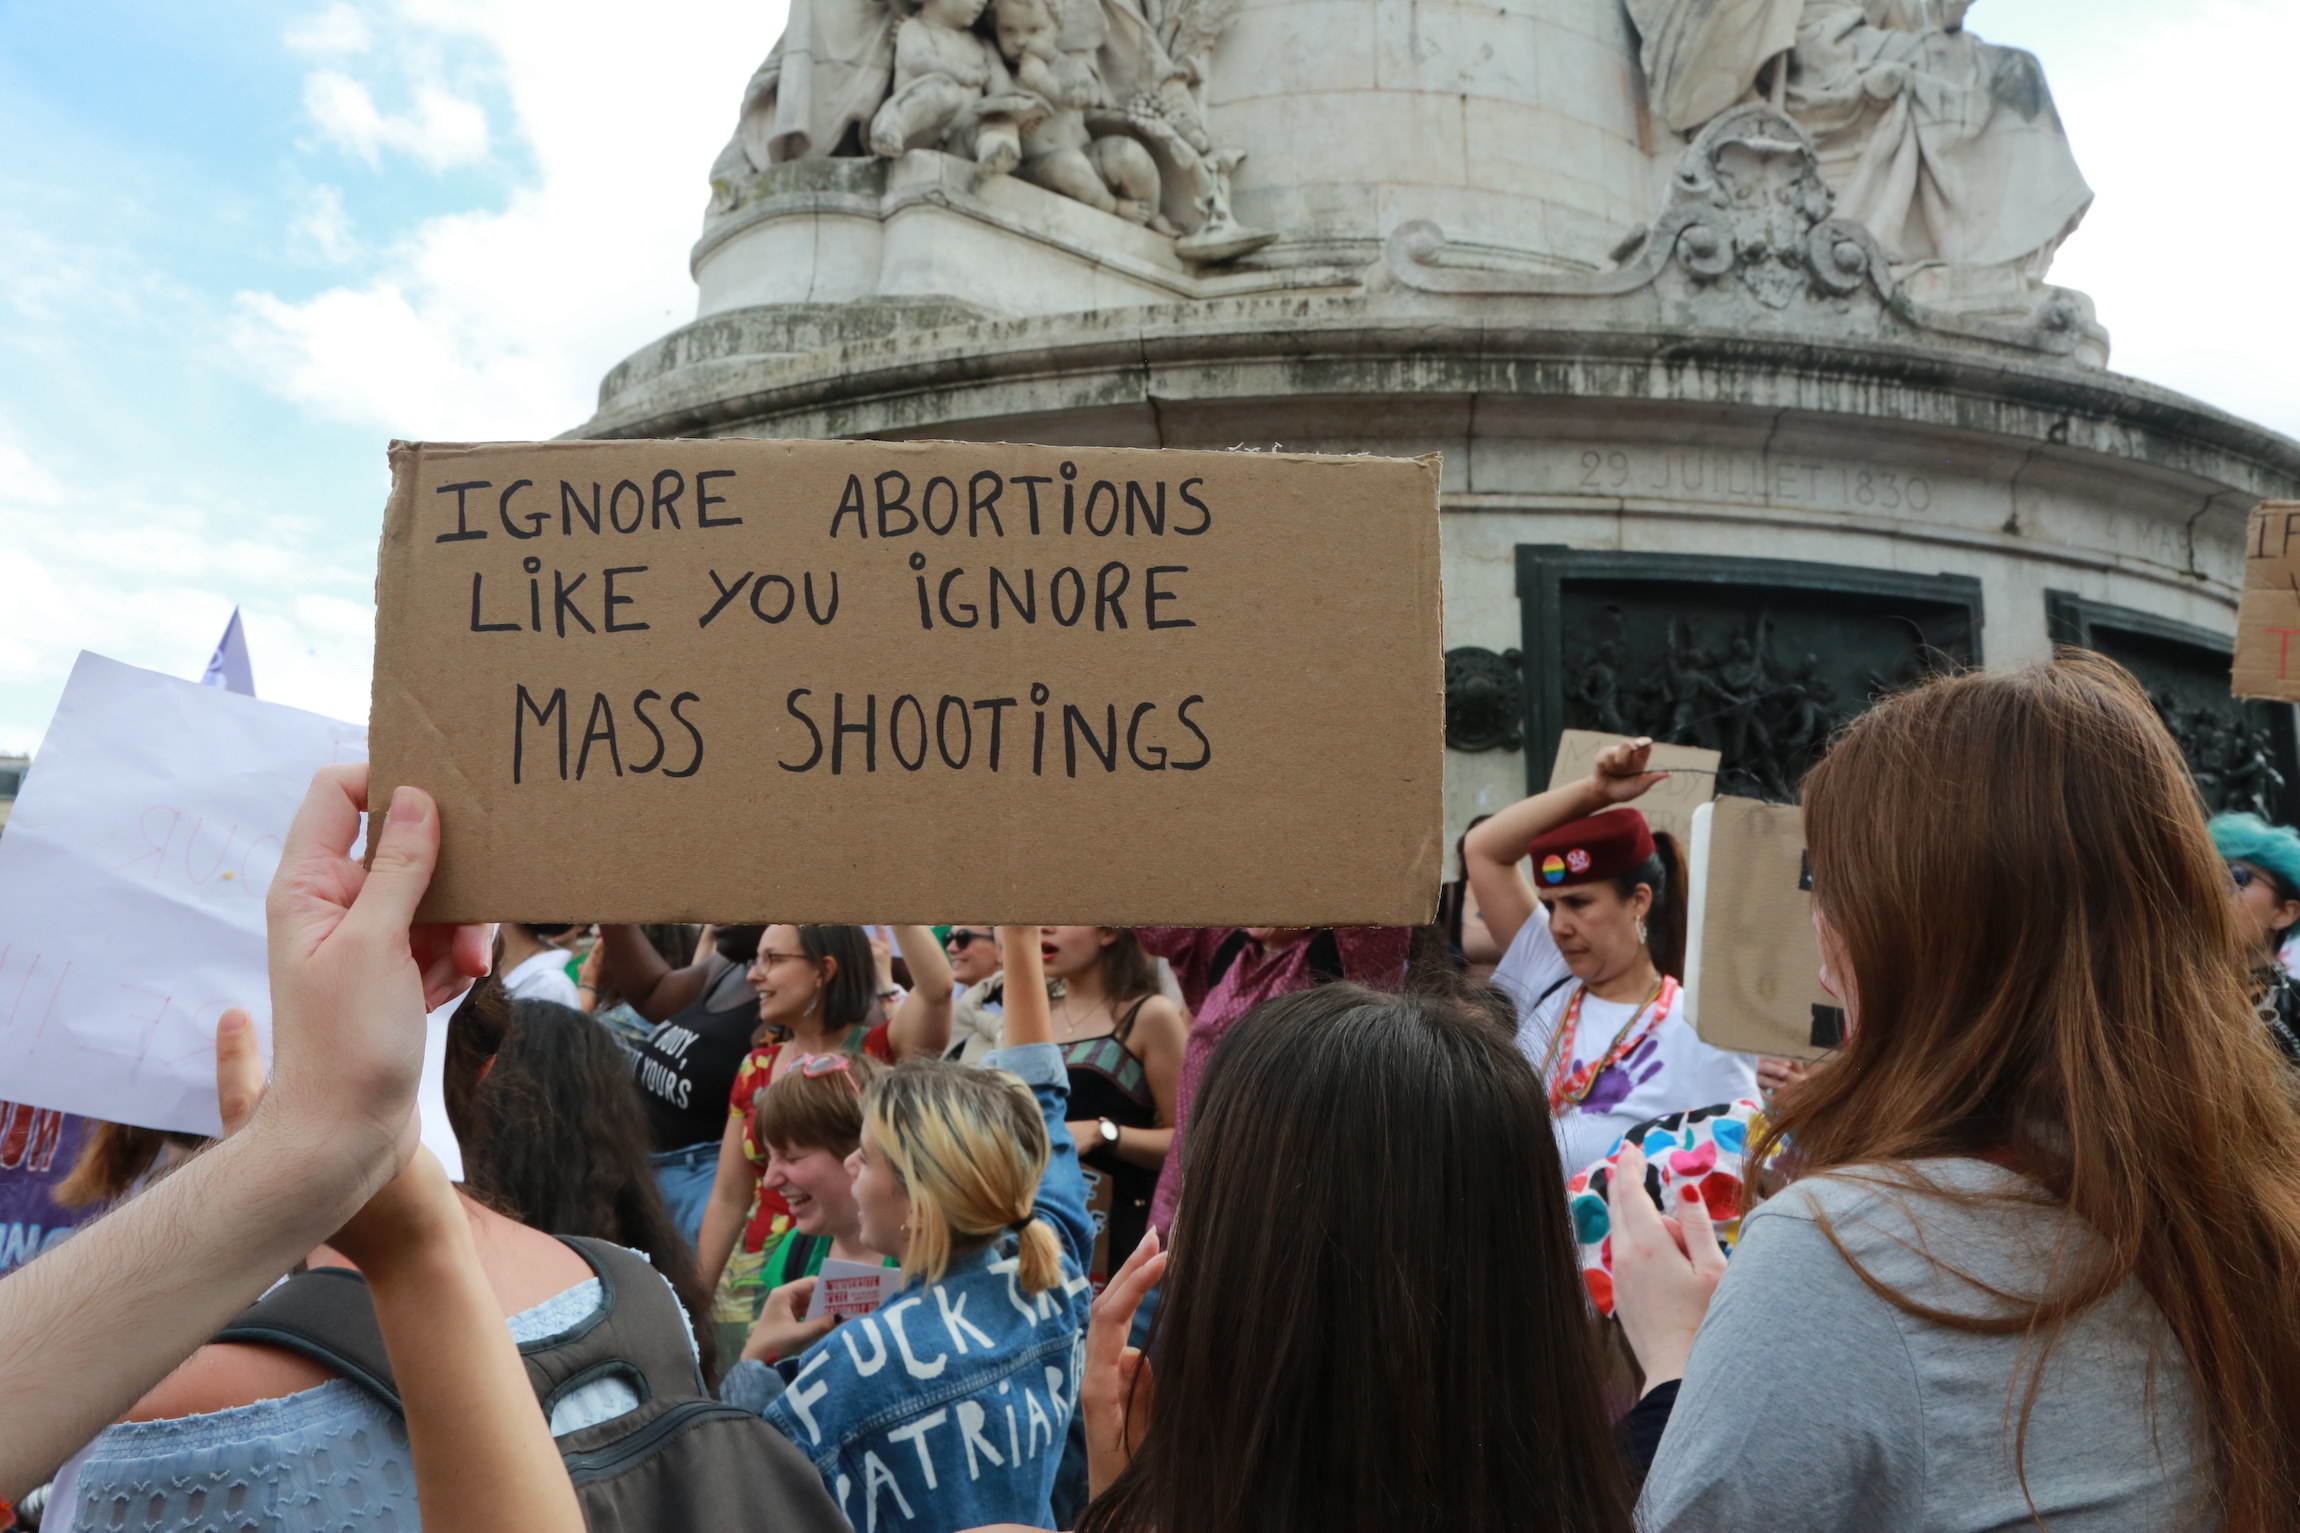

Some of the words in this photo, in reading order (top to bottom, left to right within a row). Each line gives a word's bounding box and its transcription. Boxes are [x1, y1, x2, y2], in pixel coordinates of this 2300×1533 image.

[436, 469, 743, 543] IGNORE
[1579, 451, 1629, 488] 29
[1651, 454, 1824, 500] JUILLET
[1841, 468, 1933, 513] 1830
[700, 569, 839, 629] YOU
[514, 684, 704, 784] MASS
[641, 1056, 692, 1109] YOURS
[785, 1285, 996, 1446] FUCK
